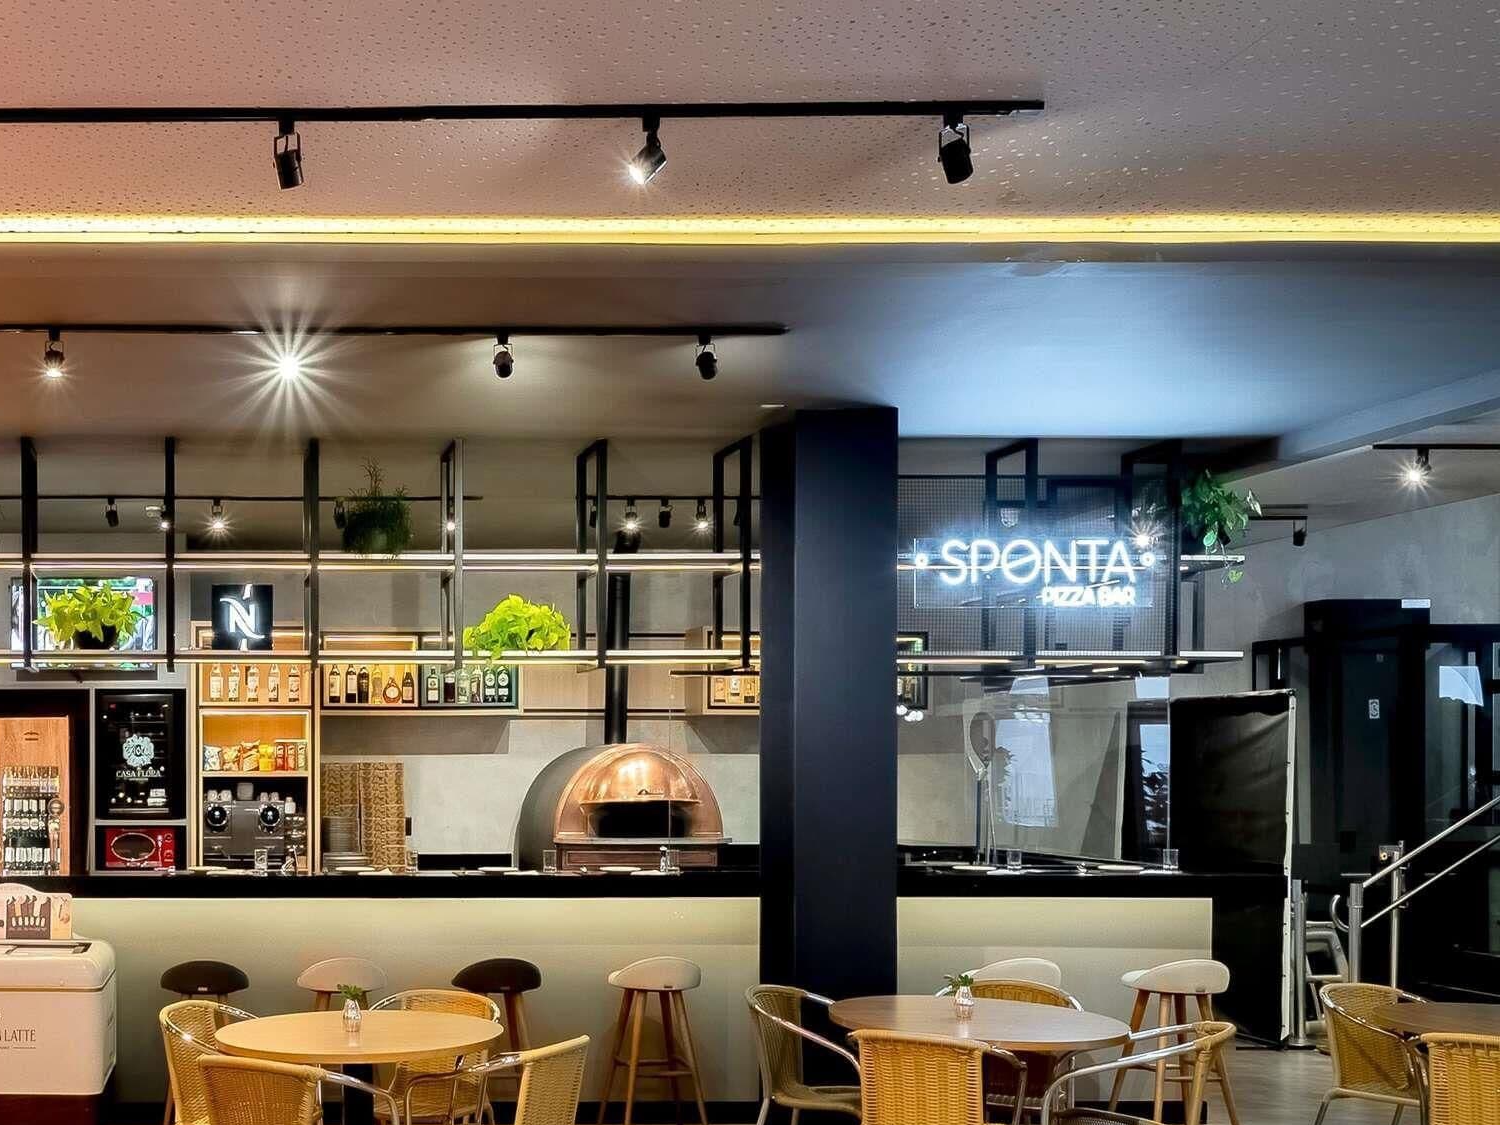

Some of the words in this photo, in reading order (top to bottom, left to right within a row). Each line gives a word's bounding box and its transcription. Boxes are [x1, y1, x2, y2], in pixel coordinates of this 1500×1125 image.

[1042, 587, 1095, 606] PIZZA
[115, 770, 136, 778] CASA
[4, 1029, 36, 1042] LATTE
